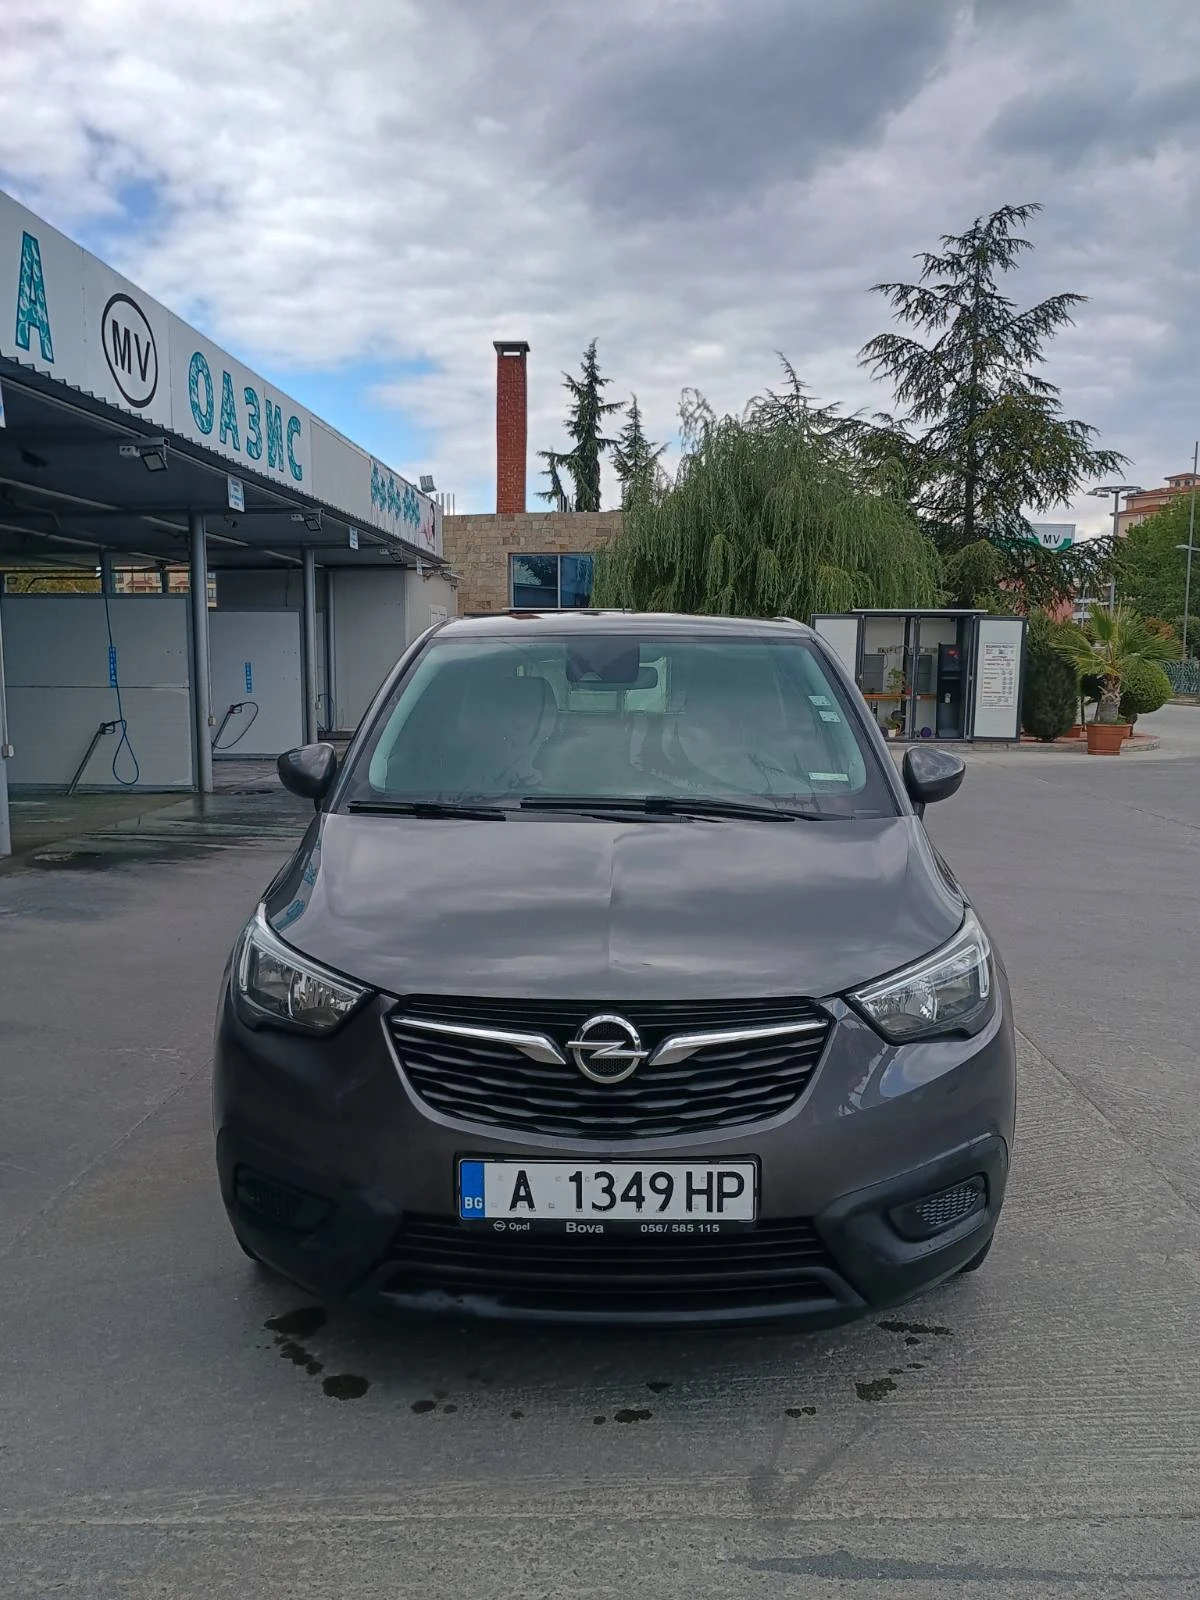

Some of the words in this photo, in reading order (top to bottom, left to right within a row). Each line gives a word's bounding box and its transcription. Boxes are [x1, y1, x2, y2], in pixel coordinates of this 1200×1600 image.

[111, 318, 151, 383] MV
[188, 351, 303, 481] ОАЗИС
[1042, 533, 1061, 545] MV
[509, 1169, 537, 1213] A
[568, 1170, 675, 1214] 1349
[464, 1196, 484, 1210] BG
[508, 1221, 531, 1233] Opel
[565, 1221, 604, 1235] Bova
[640, 1224, 668, 1234] 056/
[671, 1224, 694, 1233] 585
[697, 1224, 720, 1233] 115
